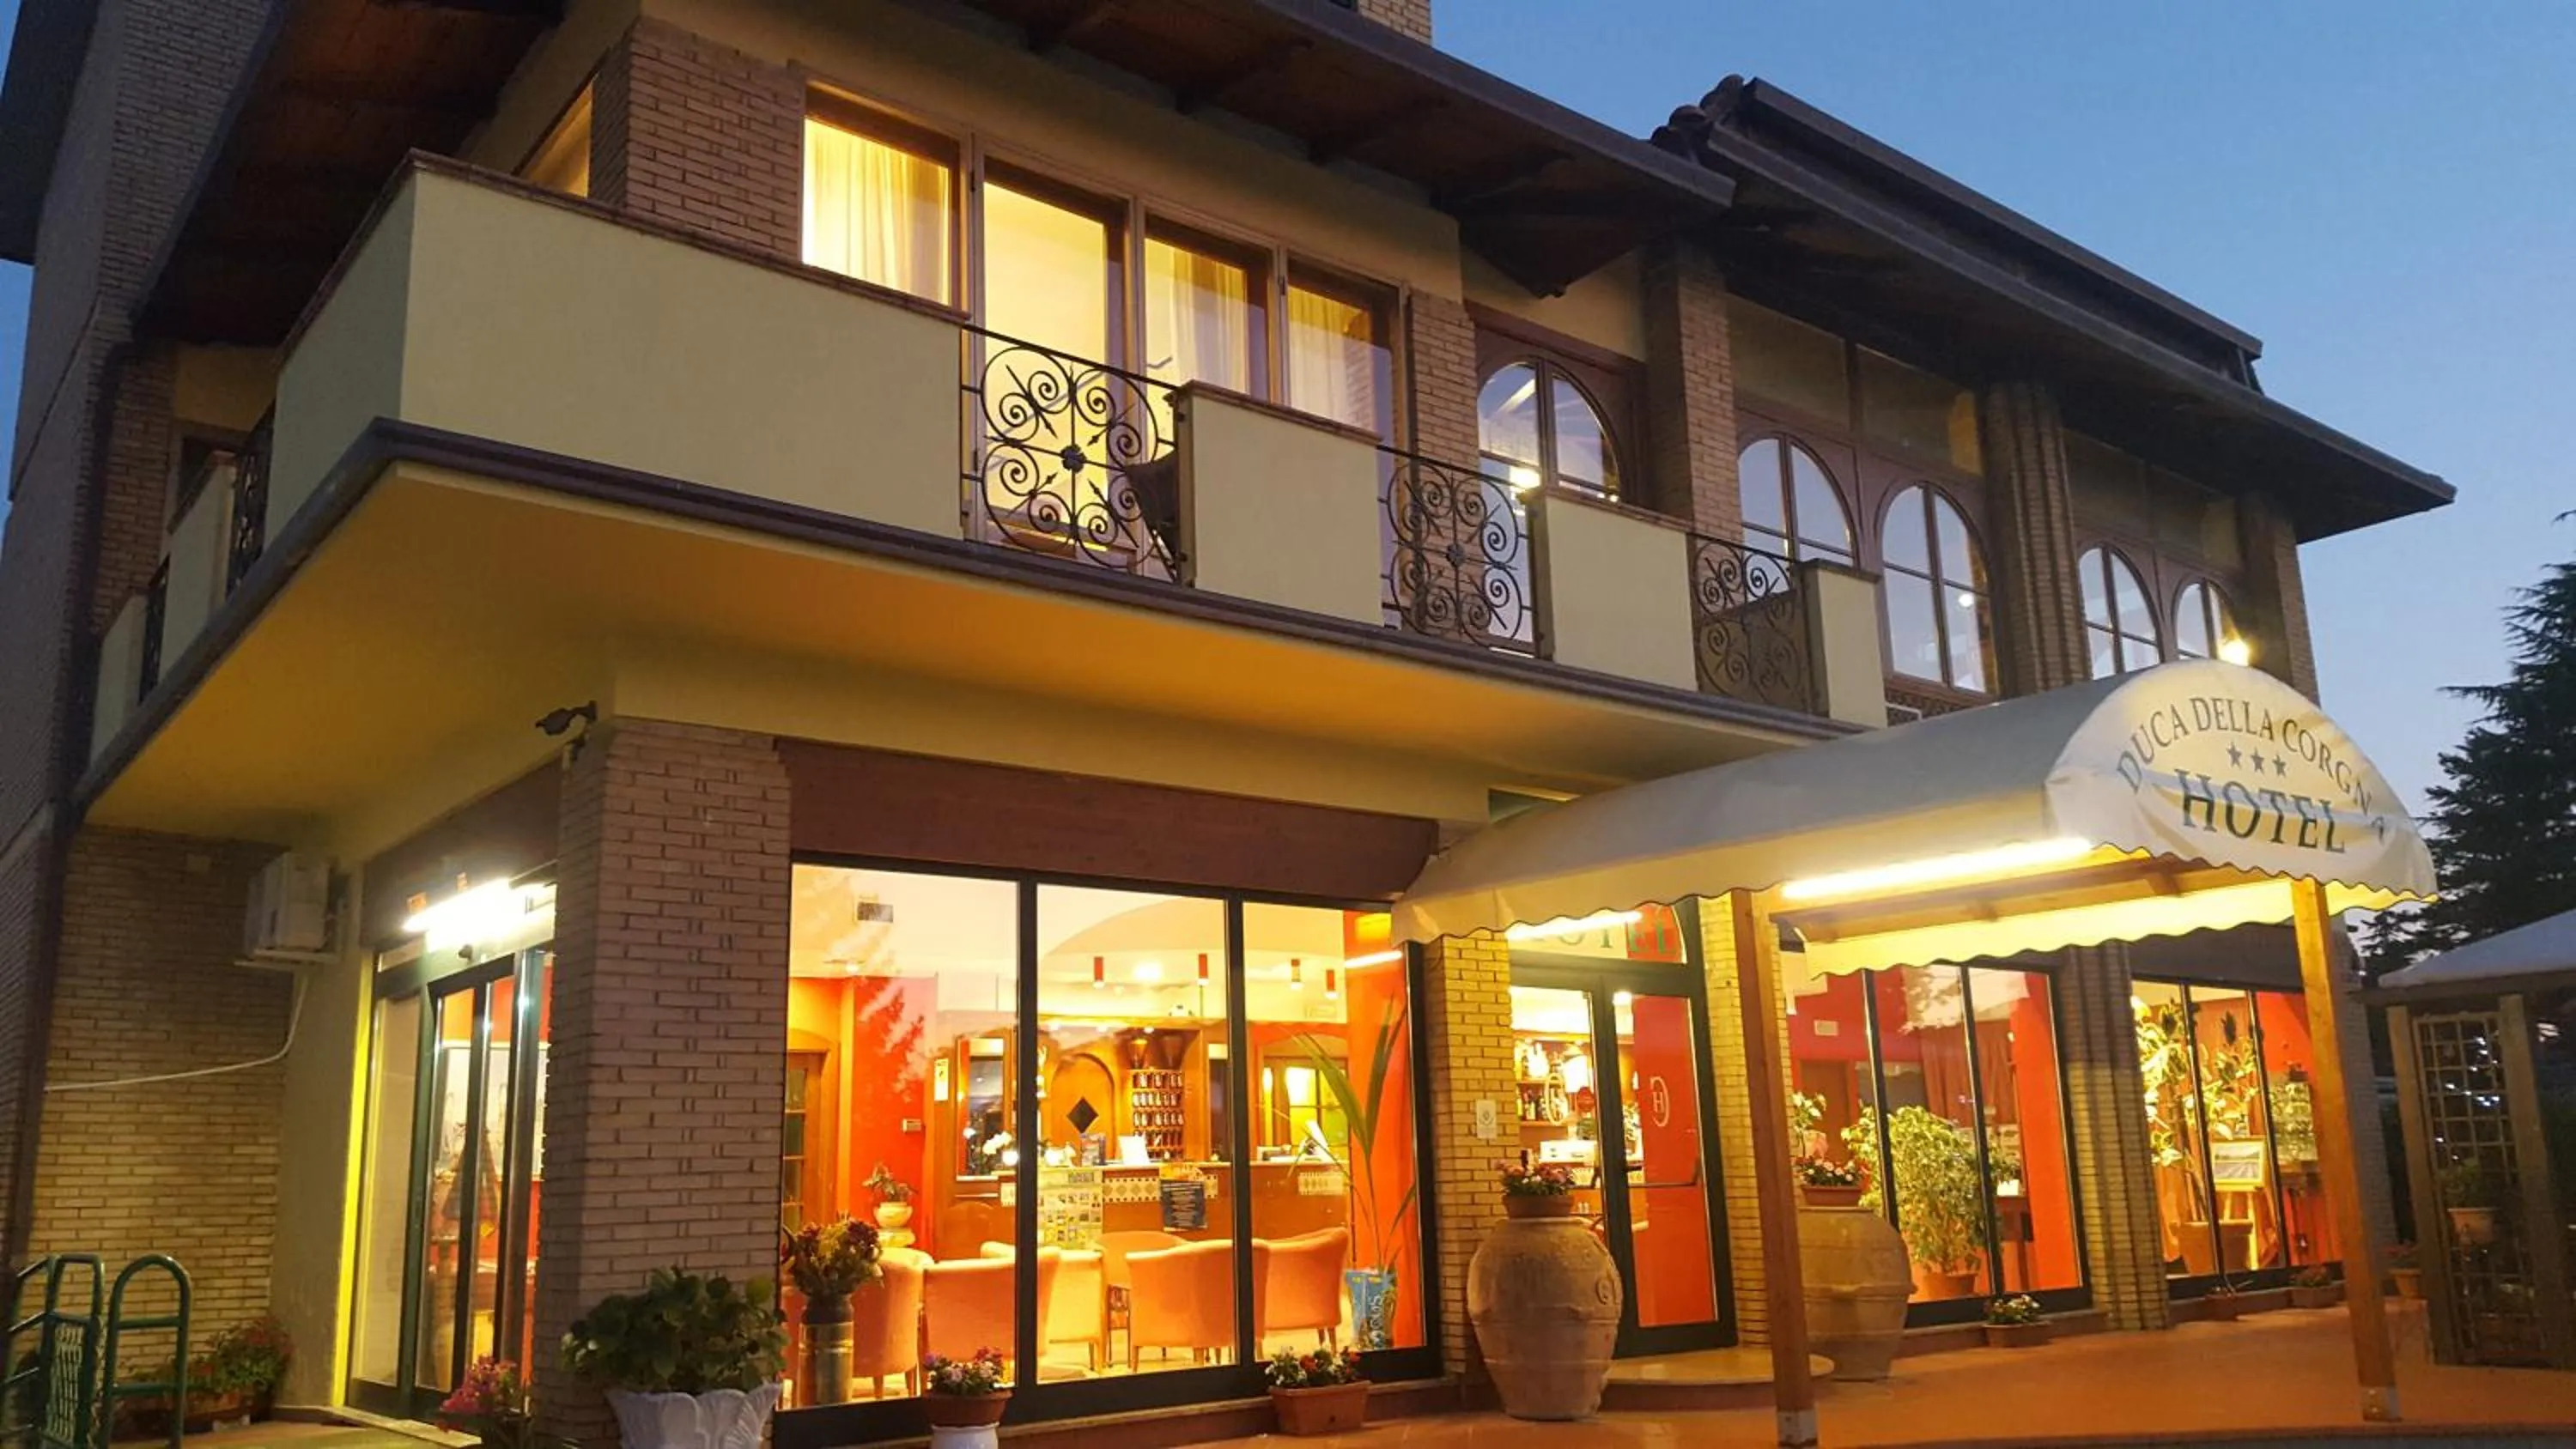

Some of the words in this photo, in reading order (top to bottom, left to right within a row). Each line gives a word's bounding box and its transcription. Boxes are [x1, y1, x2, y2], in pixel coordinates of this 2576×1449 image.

[2116, 703, 2190, 795] DUCA
[2189, 696, 2274, 742] DELLA
[2173, 767, 2345, 853] HOTEL
